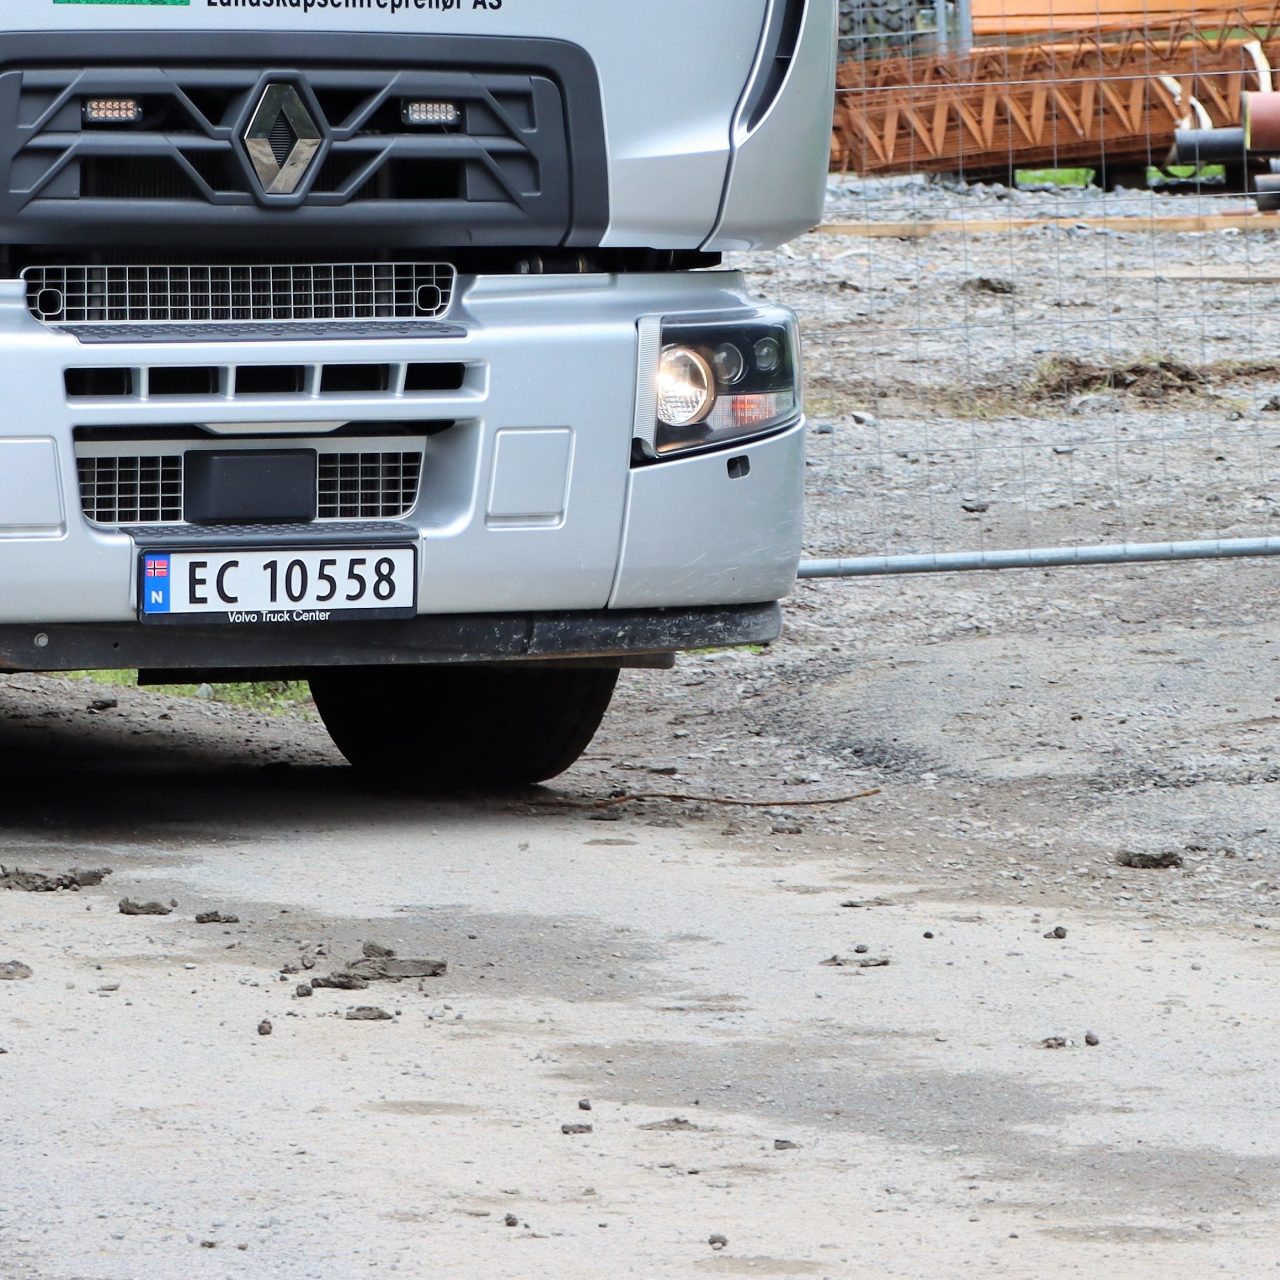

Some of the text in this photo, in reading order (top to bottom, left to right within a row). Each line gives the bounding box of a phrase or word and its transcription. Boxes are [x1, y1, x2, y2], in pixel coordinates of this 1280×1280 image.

[189, 557, 396, 604] EC 10558
[228, 609, 331, 623] Volvo Truck Center
